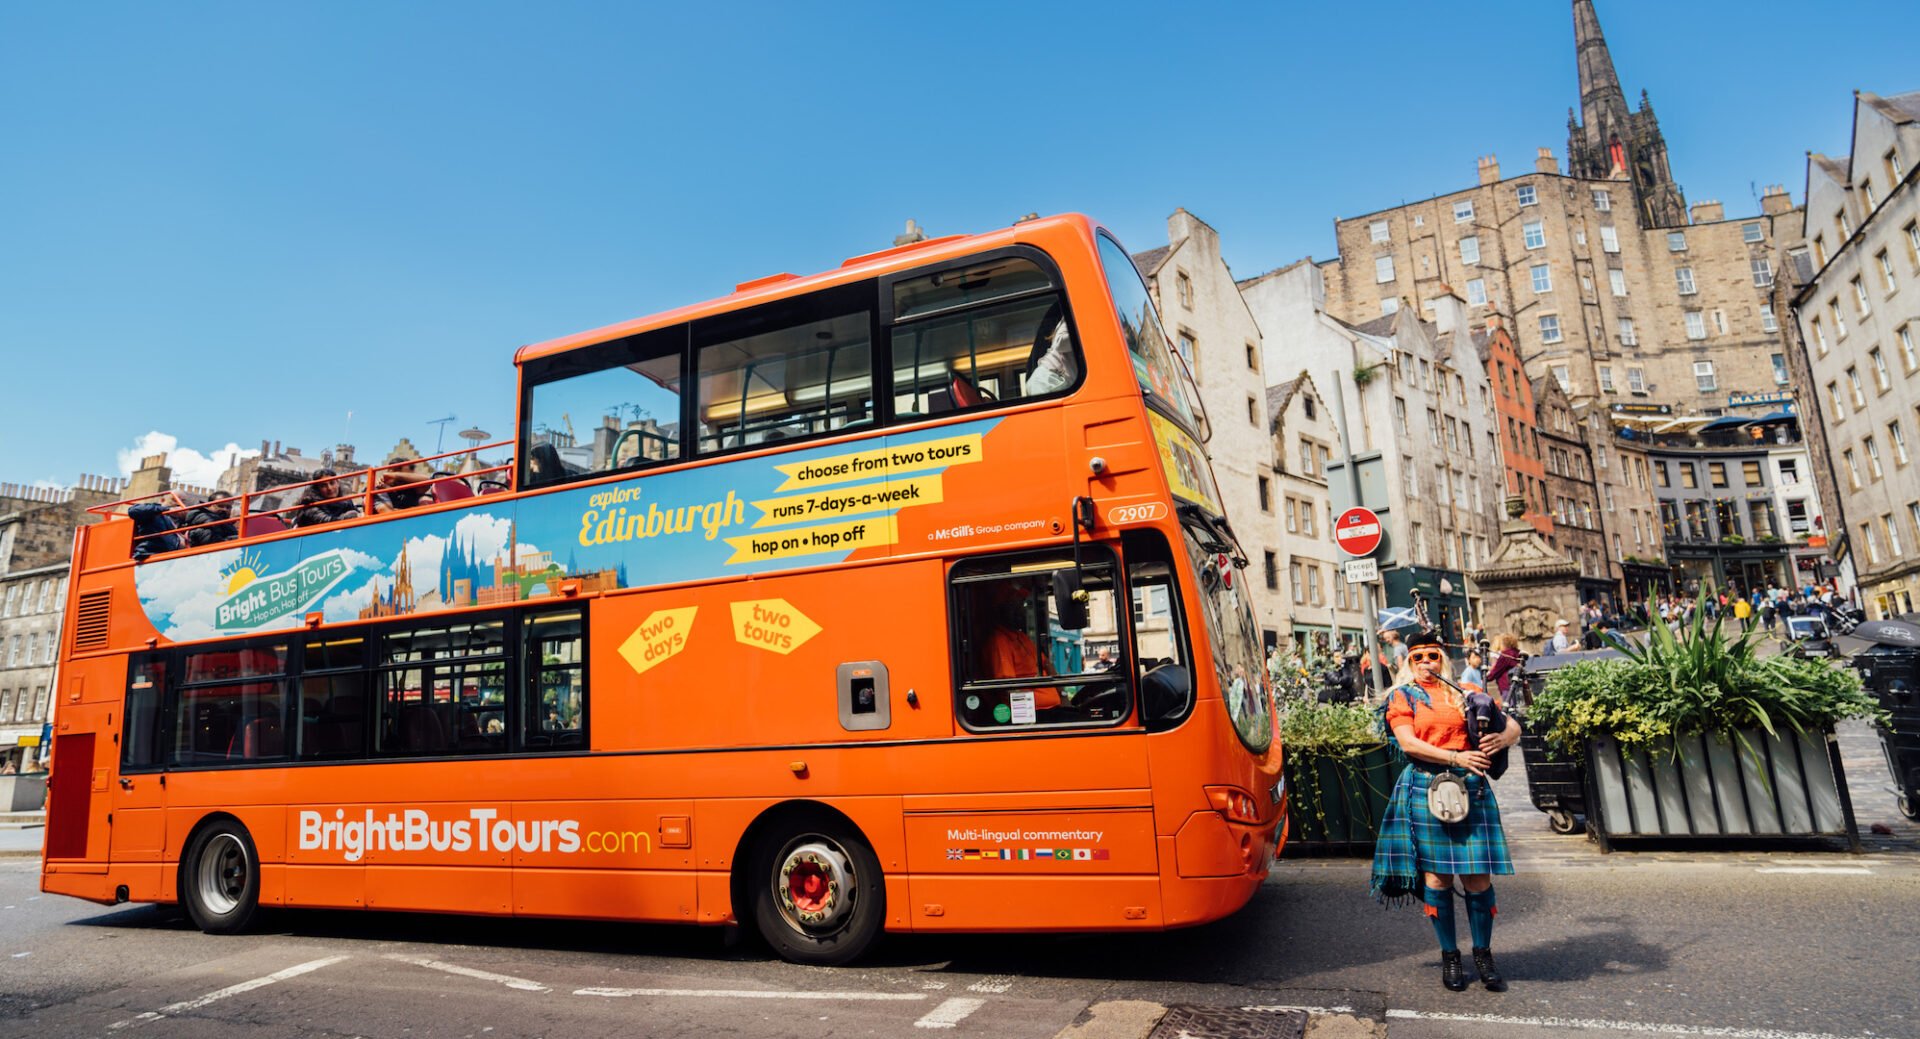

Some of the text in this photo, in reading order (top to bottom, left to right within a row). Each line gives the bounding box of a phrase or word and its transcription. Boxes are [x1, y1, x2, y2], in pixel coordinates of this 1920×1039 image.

[797, 444, 971, 481] choose from two tours
[589, 486, 641, 511] explore
[772, 484, 920, 518] runs 7-days-a-week
[578, 490, 745, 547] Edinburgh
[1119, 505, 1156, 522] 2907
[752, 525, 865, 555] hop on hop off
[927, 519, 1046, 541] a McGill's Group company
[1347, 561, 1374, 572] Except
[1349, 571, 1374, 580] cyles
[219, 558, 342, 626] Bright Bus Tours
[253, 611, 269, 623] Hop
[281, 598, 297, 611] Hop
[298, 588, 309, 603] off
[640, 615, 675, 642] two
[752, 603, 791, 628] two
[643, 631, 683, 662] days
[743, 621, 792, 649] tours
[1092, 644, 1120, 655] HTEL
[299, 808, 651, 861] BrightBusTours.com
[947, 829, 1104, 843] Multi-lingual commentary
